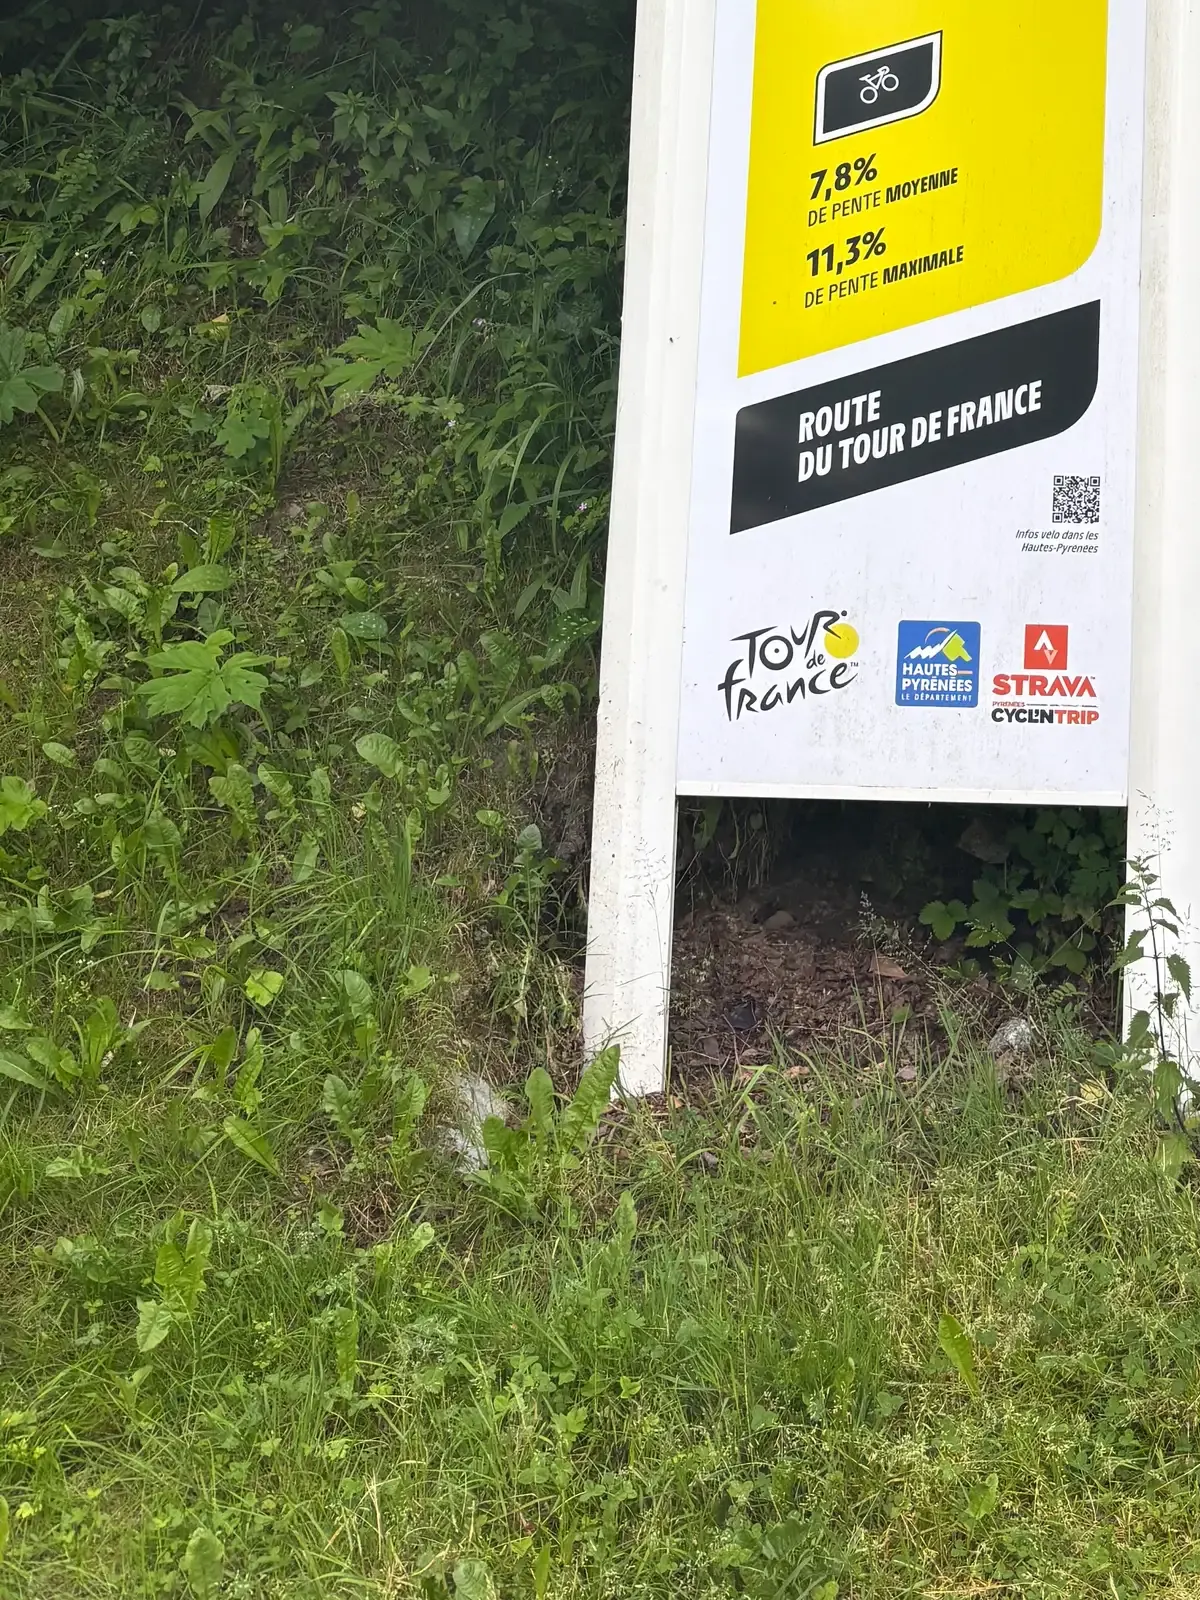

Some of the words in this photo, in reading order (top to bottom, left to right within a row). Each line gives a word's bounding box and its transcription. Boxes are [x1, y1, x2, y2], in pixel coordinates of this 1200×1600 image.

[808, 207, 827, 227] DE
[832, 190, 881, 220] PENTE
[886, 167, 959, 204] MOYENNE
[809, 153, 878, 201] 7,8%
[806, 227, 886, 277] 11,3%
[804, 288, 824, 309] DE
[829, 271, 878, 301] PENTE
[882, 245, 964, 285] MAXIMALE
[798, 390, 881, 444] ROUTE
[798, 444, 832, 483] DU
[839, 422, 906, 470] TOUR
[911, 410, 942, 448] DE
[947, 380, 1042, 438] FRANCE
[1015, 529, 1039, 539] Infos
[1041, 530, 1060, 539] vélo
[1062, 530, 1084, 540] dans
[1085, 531, 1099, 540] les
[806, 649, 826, 669] de
[901, 693, 910, 701] LE
[915, 692, 972, 702] DÉPARTEMENT
[992, 674, 1097, 697] STRAVA
